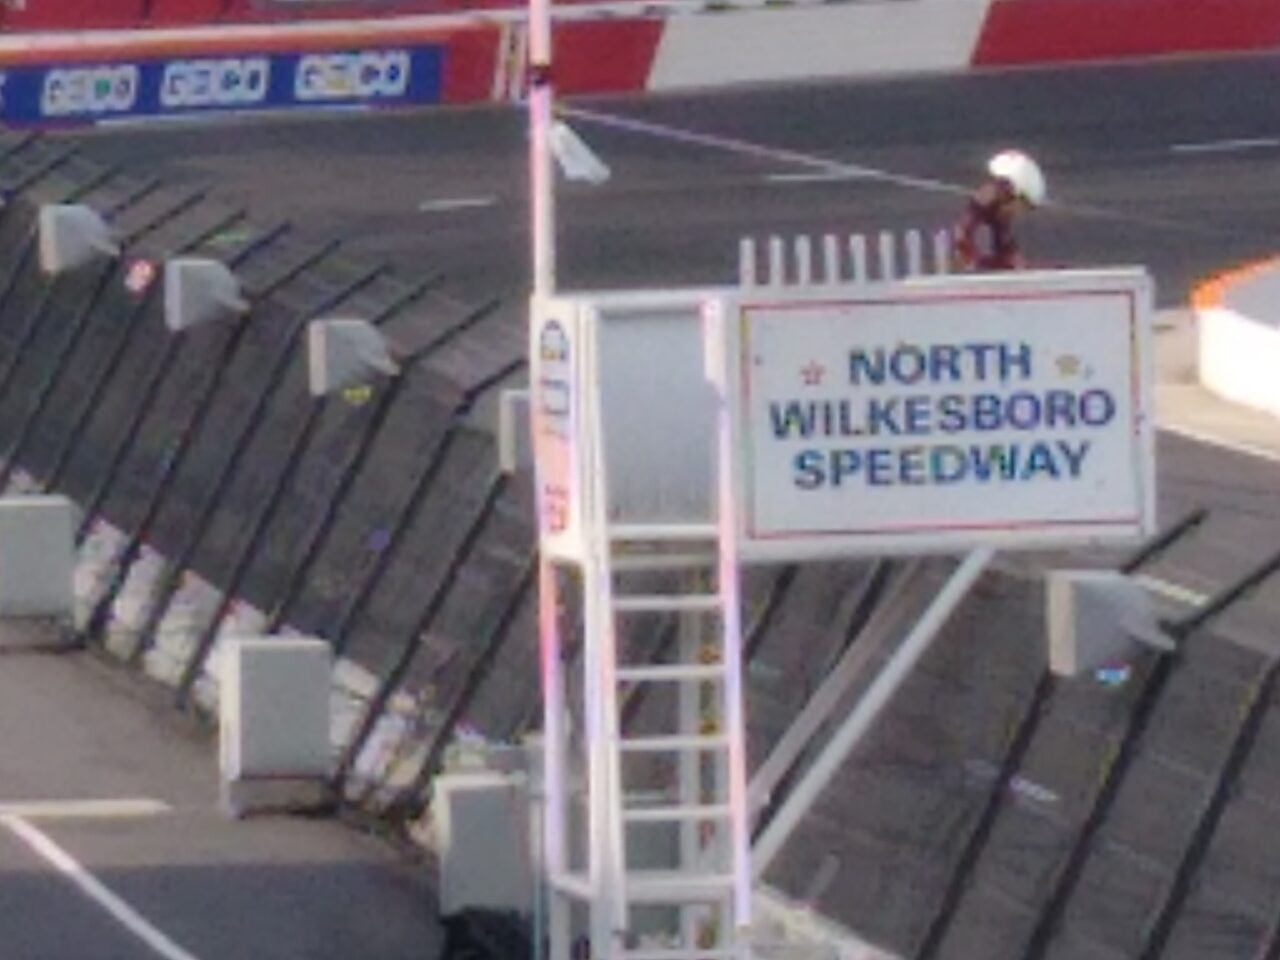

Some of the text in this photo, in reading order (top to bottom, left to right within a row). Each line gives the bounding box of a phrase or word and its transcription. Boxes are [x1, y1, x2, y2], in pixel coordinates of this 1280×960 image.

[42, 65, 138, 114] GEICO
[161, 58, 269, 104] GEICO
[295, 50, 410, 99] GEICO
[847, 343, 1033, 387] NORTH
[768, 387, 1117, 439] WILKESBORO
[791, 441, 1092, 491] SPEEDWAY
